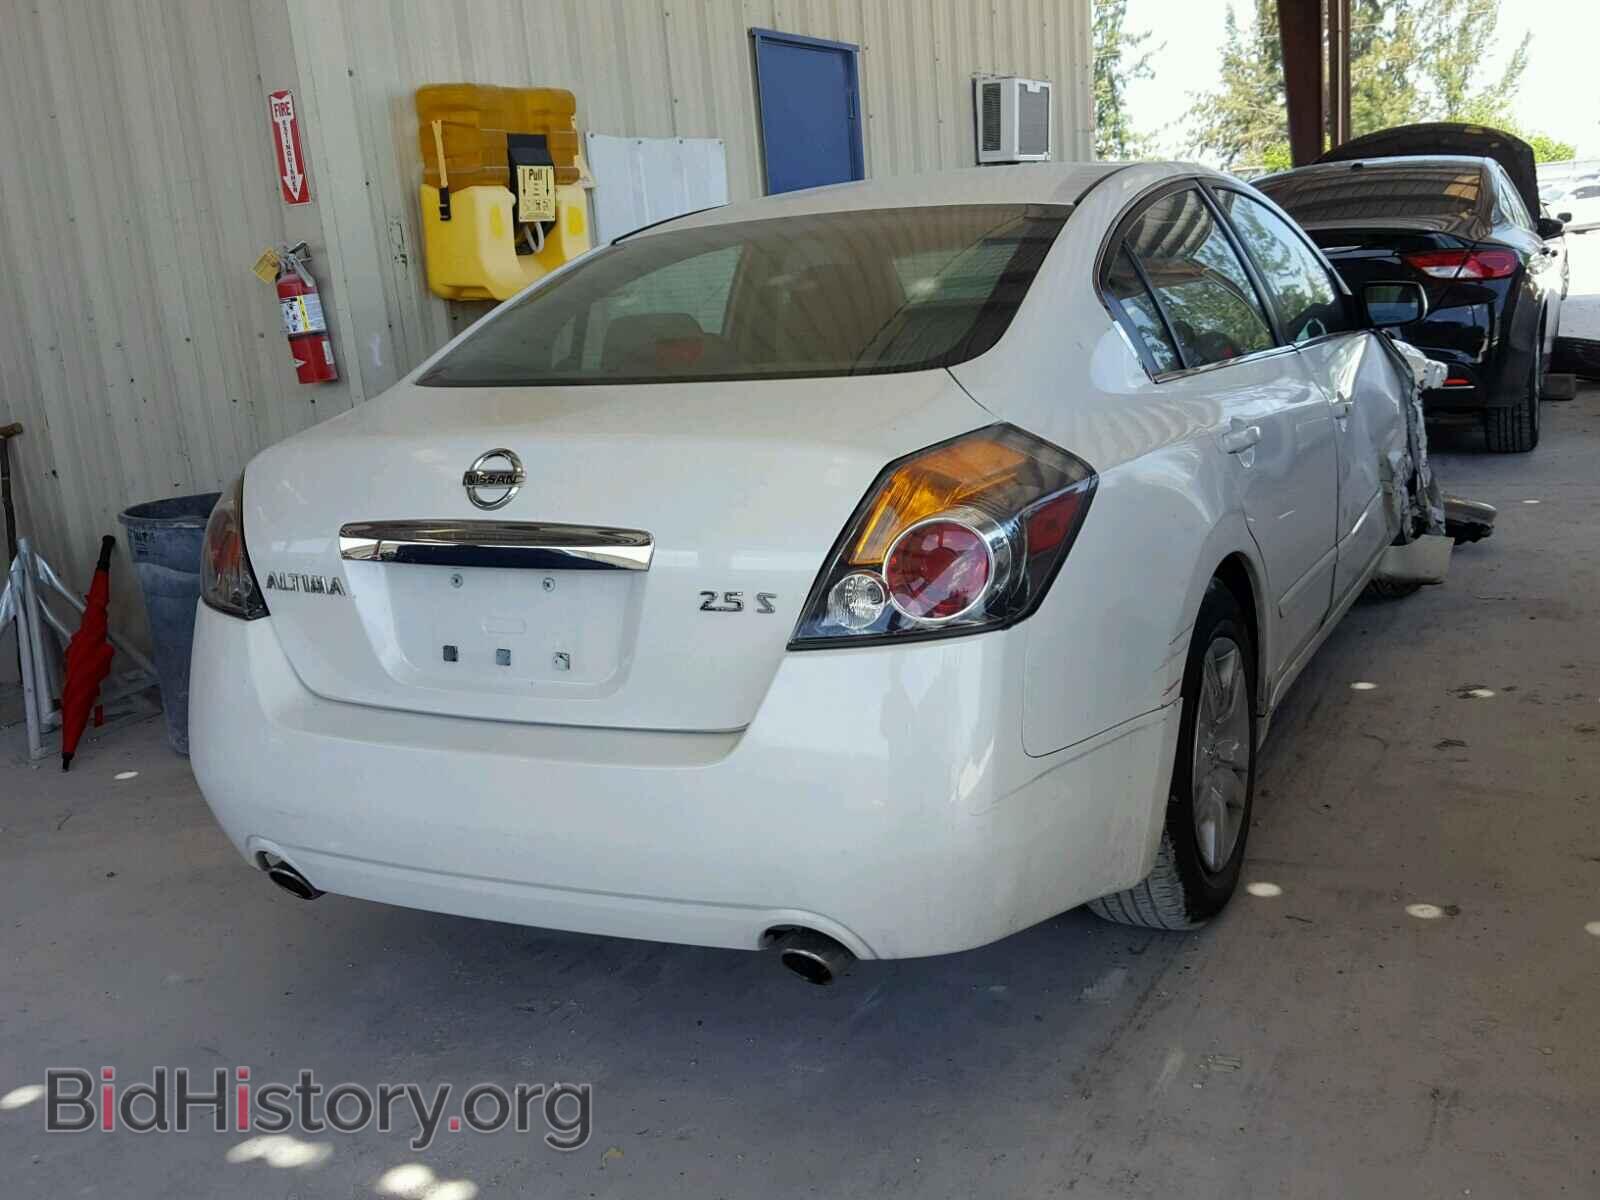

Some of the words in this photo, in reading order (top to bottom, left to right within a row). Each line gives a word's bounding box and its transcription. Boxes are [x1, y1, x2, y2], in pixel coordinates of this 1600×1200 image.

[273, 101, 291, 117] FIRE
[282, 120, 298, 193] EXTINGUISHER
[528, 168, 543, 181] Pull
[466, 473, 517, 486] NISSAN
[266, 571, 346, 596] ALTIMA
[756, 592, 777, 614] S
